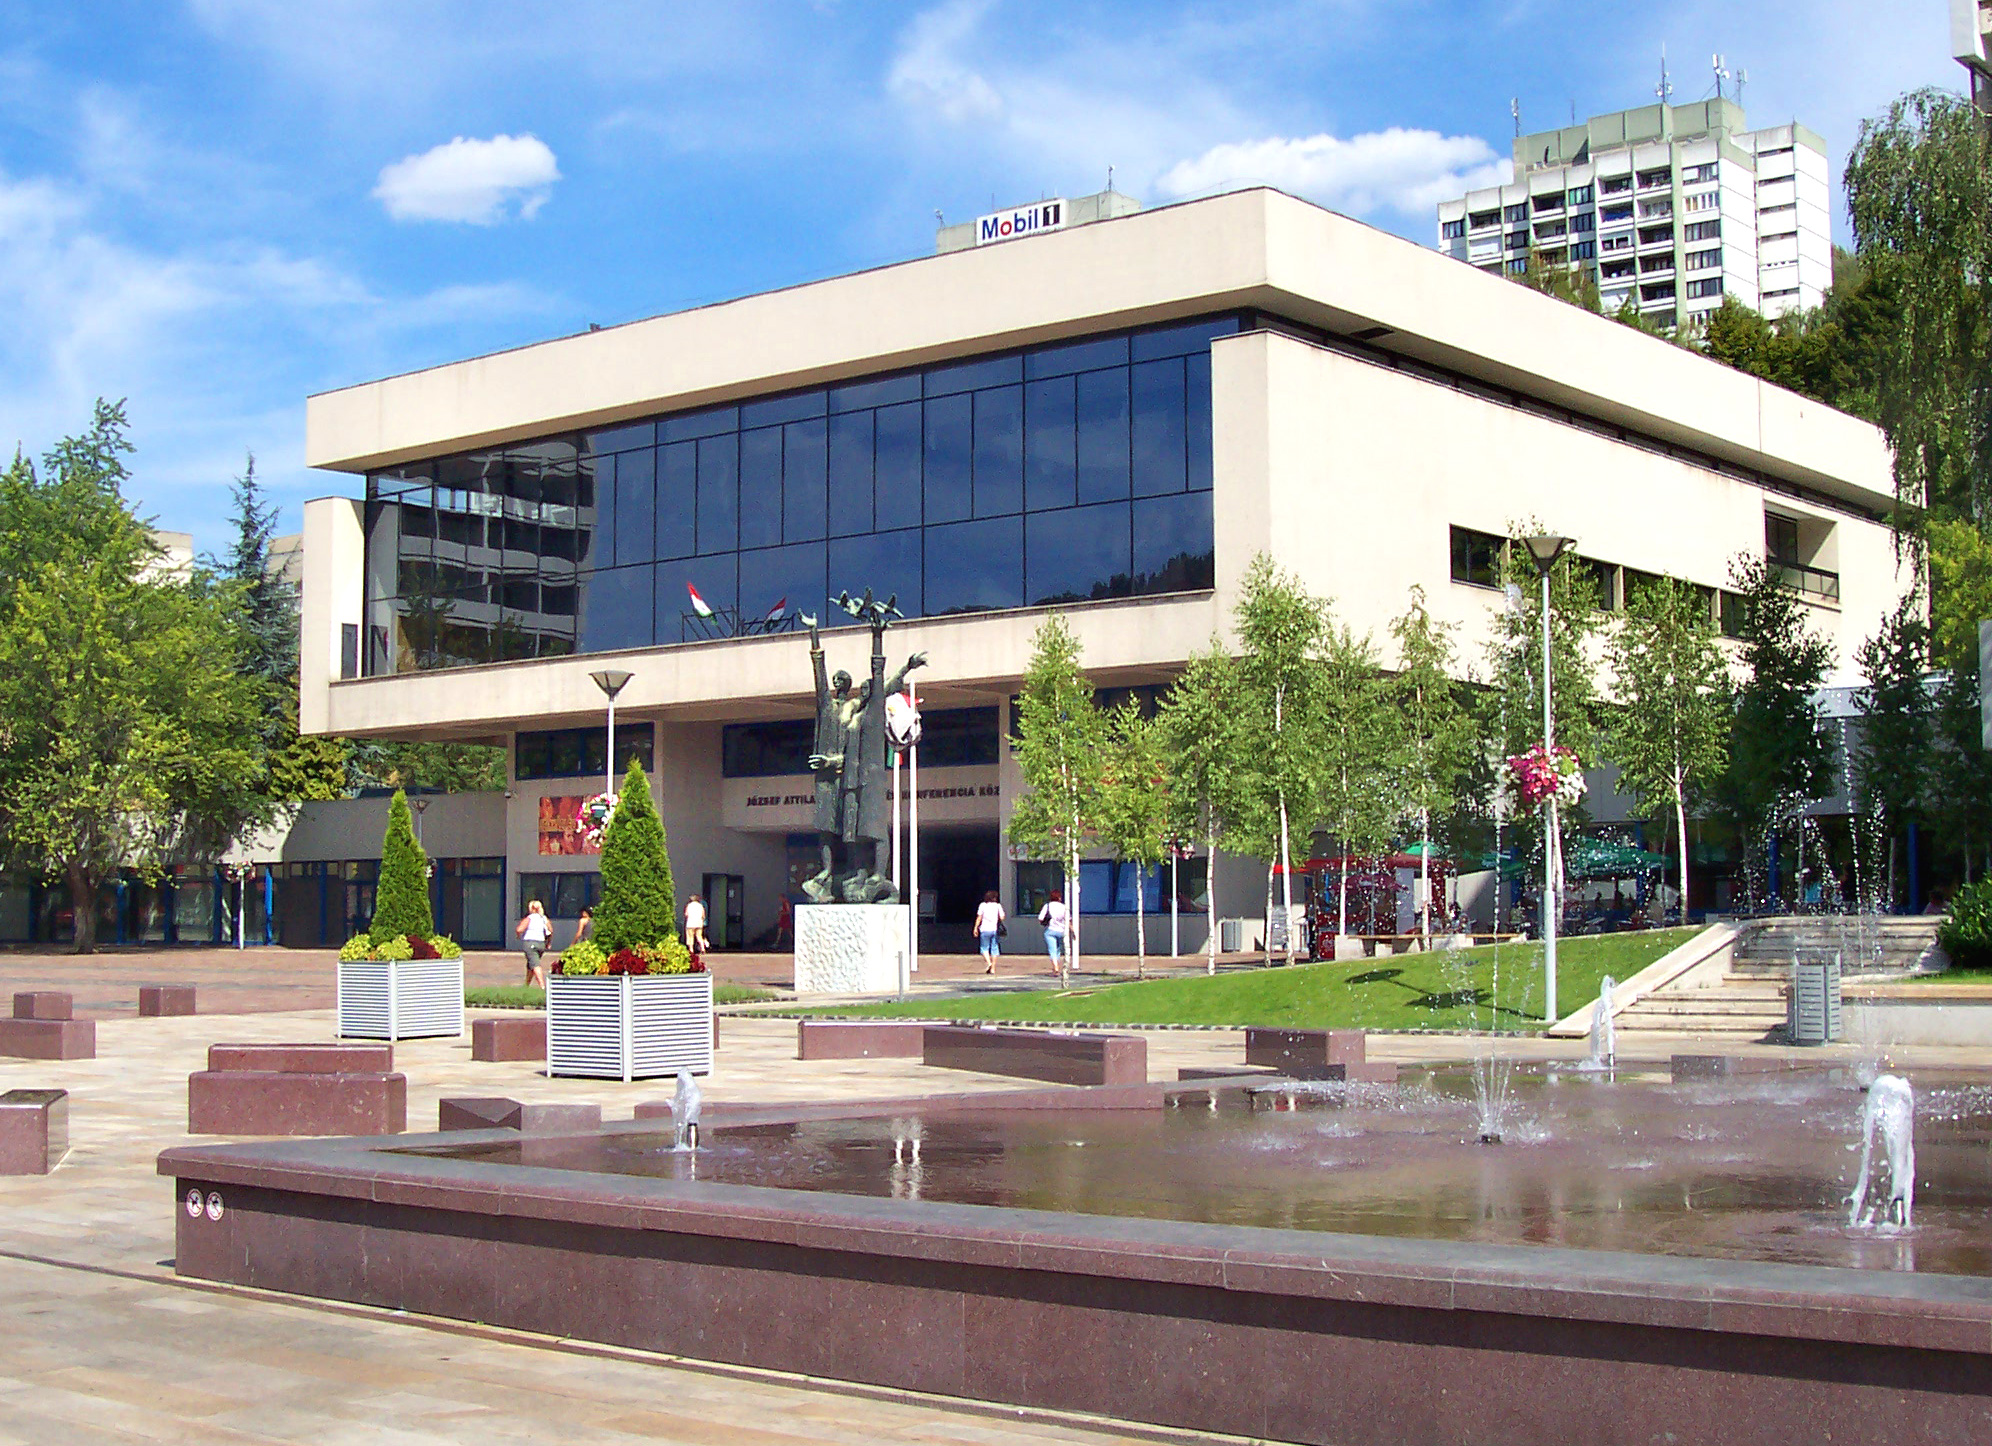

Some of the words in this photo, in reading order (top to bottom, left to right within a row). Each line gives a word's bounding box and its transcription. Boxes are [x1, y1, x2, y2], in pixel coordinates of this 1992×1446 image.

[982, 208, 1038, 241] Mobil
[1044, 205, 1058, 227] 1
[784, 794, 816, 805] ATTILA
